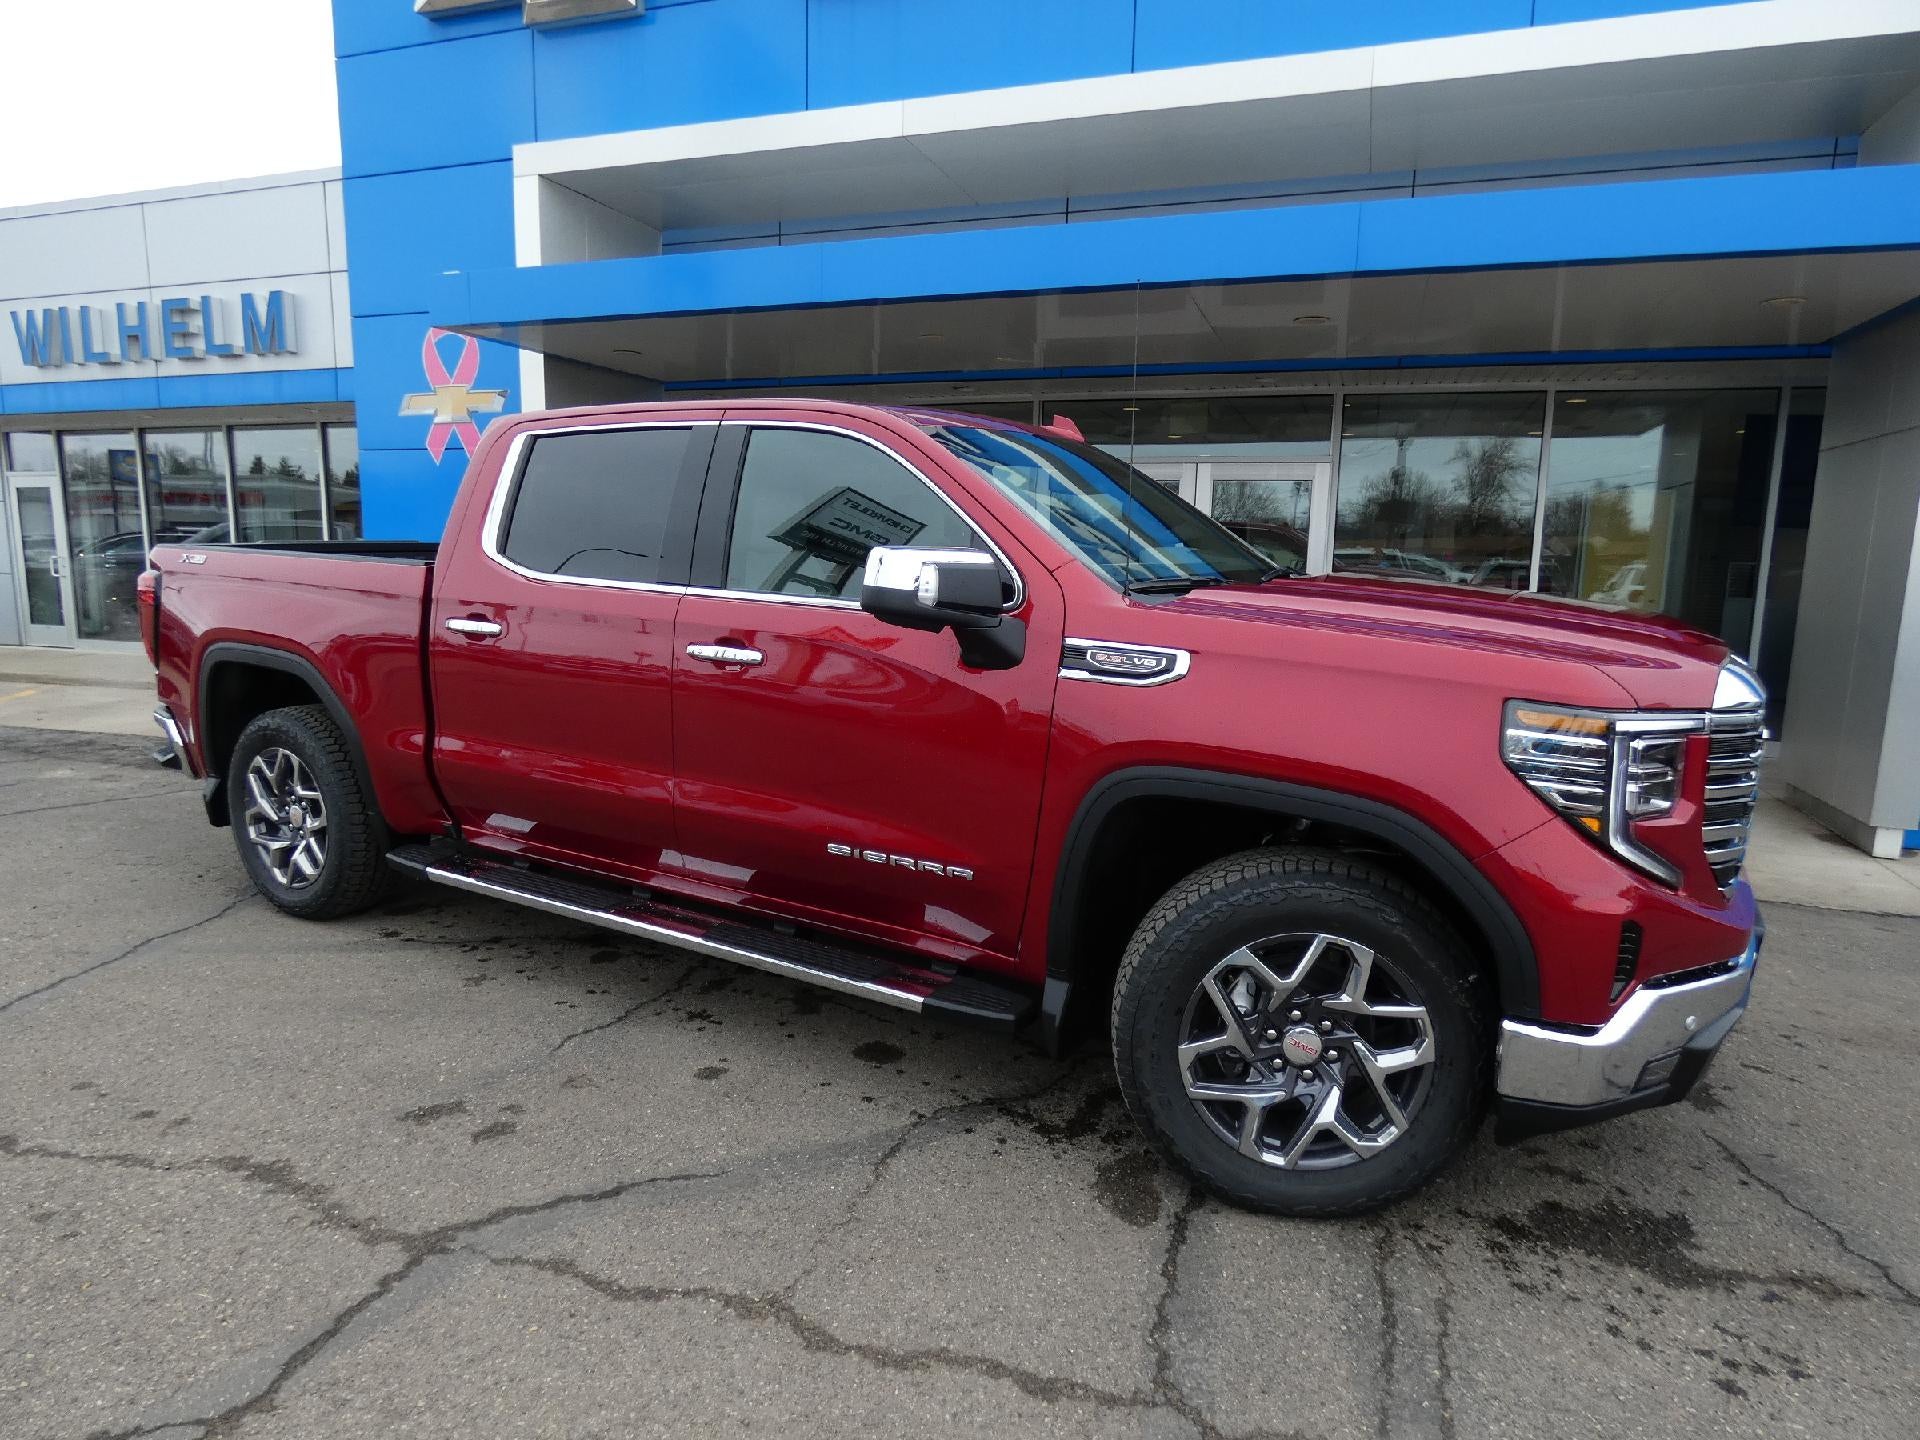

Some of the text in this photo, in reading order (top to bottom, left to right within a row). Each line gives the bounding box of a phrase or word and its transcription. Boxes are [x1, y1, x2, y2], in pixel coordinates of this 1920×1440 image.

[10, 290, 290, 367] WILHELM
[827, 843, 974, 880] SIERRA
[1287, 1037, 1319, 1056] GMC
